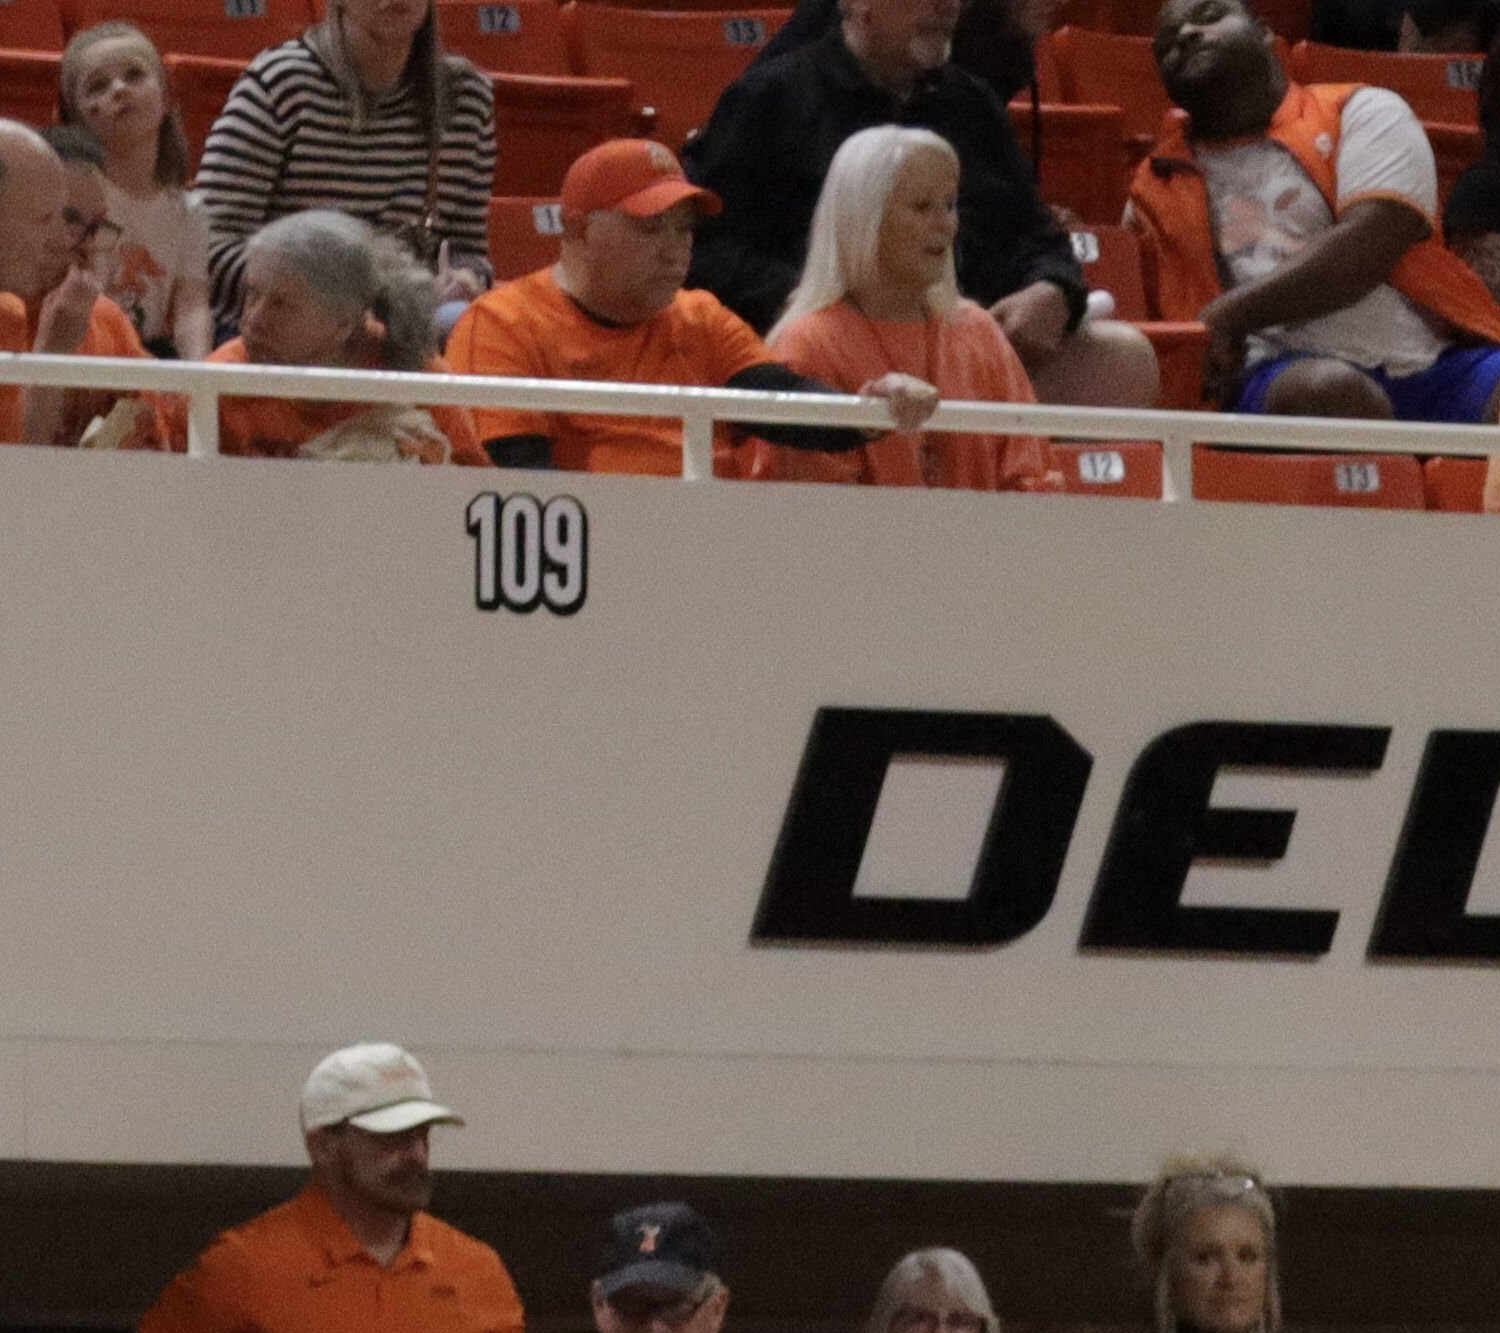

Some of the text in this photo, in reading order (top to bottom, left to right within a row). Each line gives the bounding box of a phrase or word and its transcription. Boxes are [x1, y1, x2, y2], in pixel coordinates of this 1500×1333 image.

[1089, 454, 1112, 480] 12
[1346, 463, 1369, 490] 13
[466, 492, 589, 616] 109
